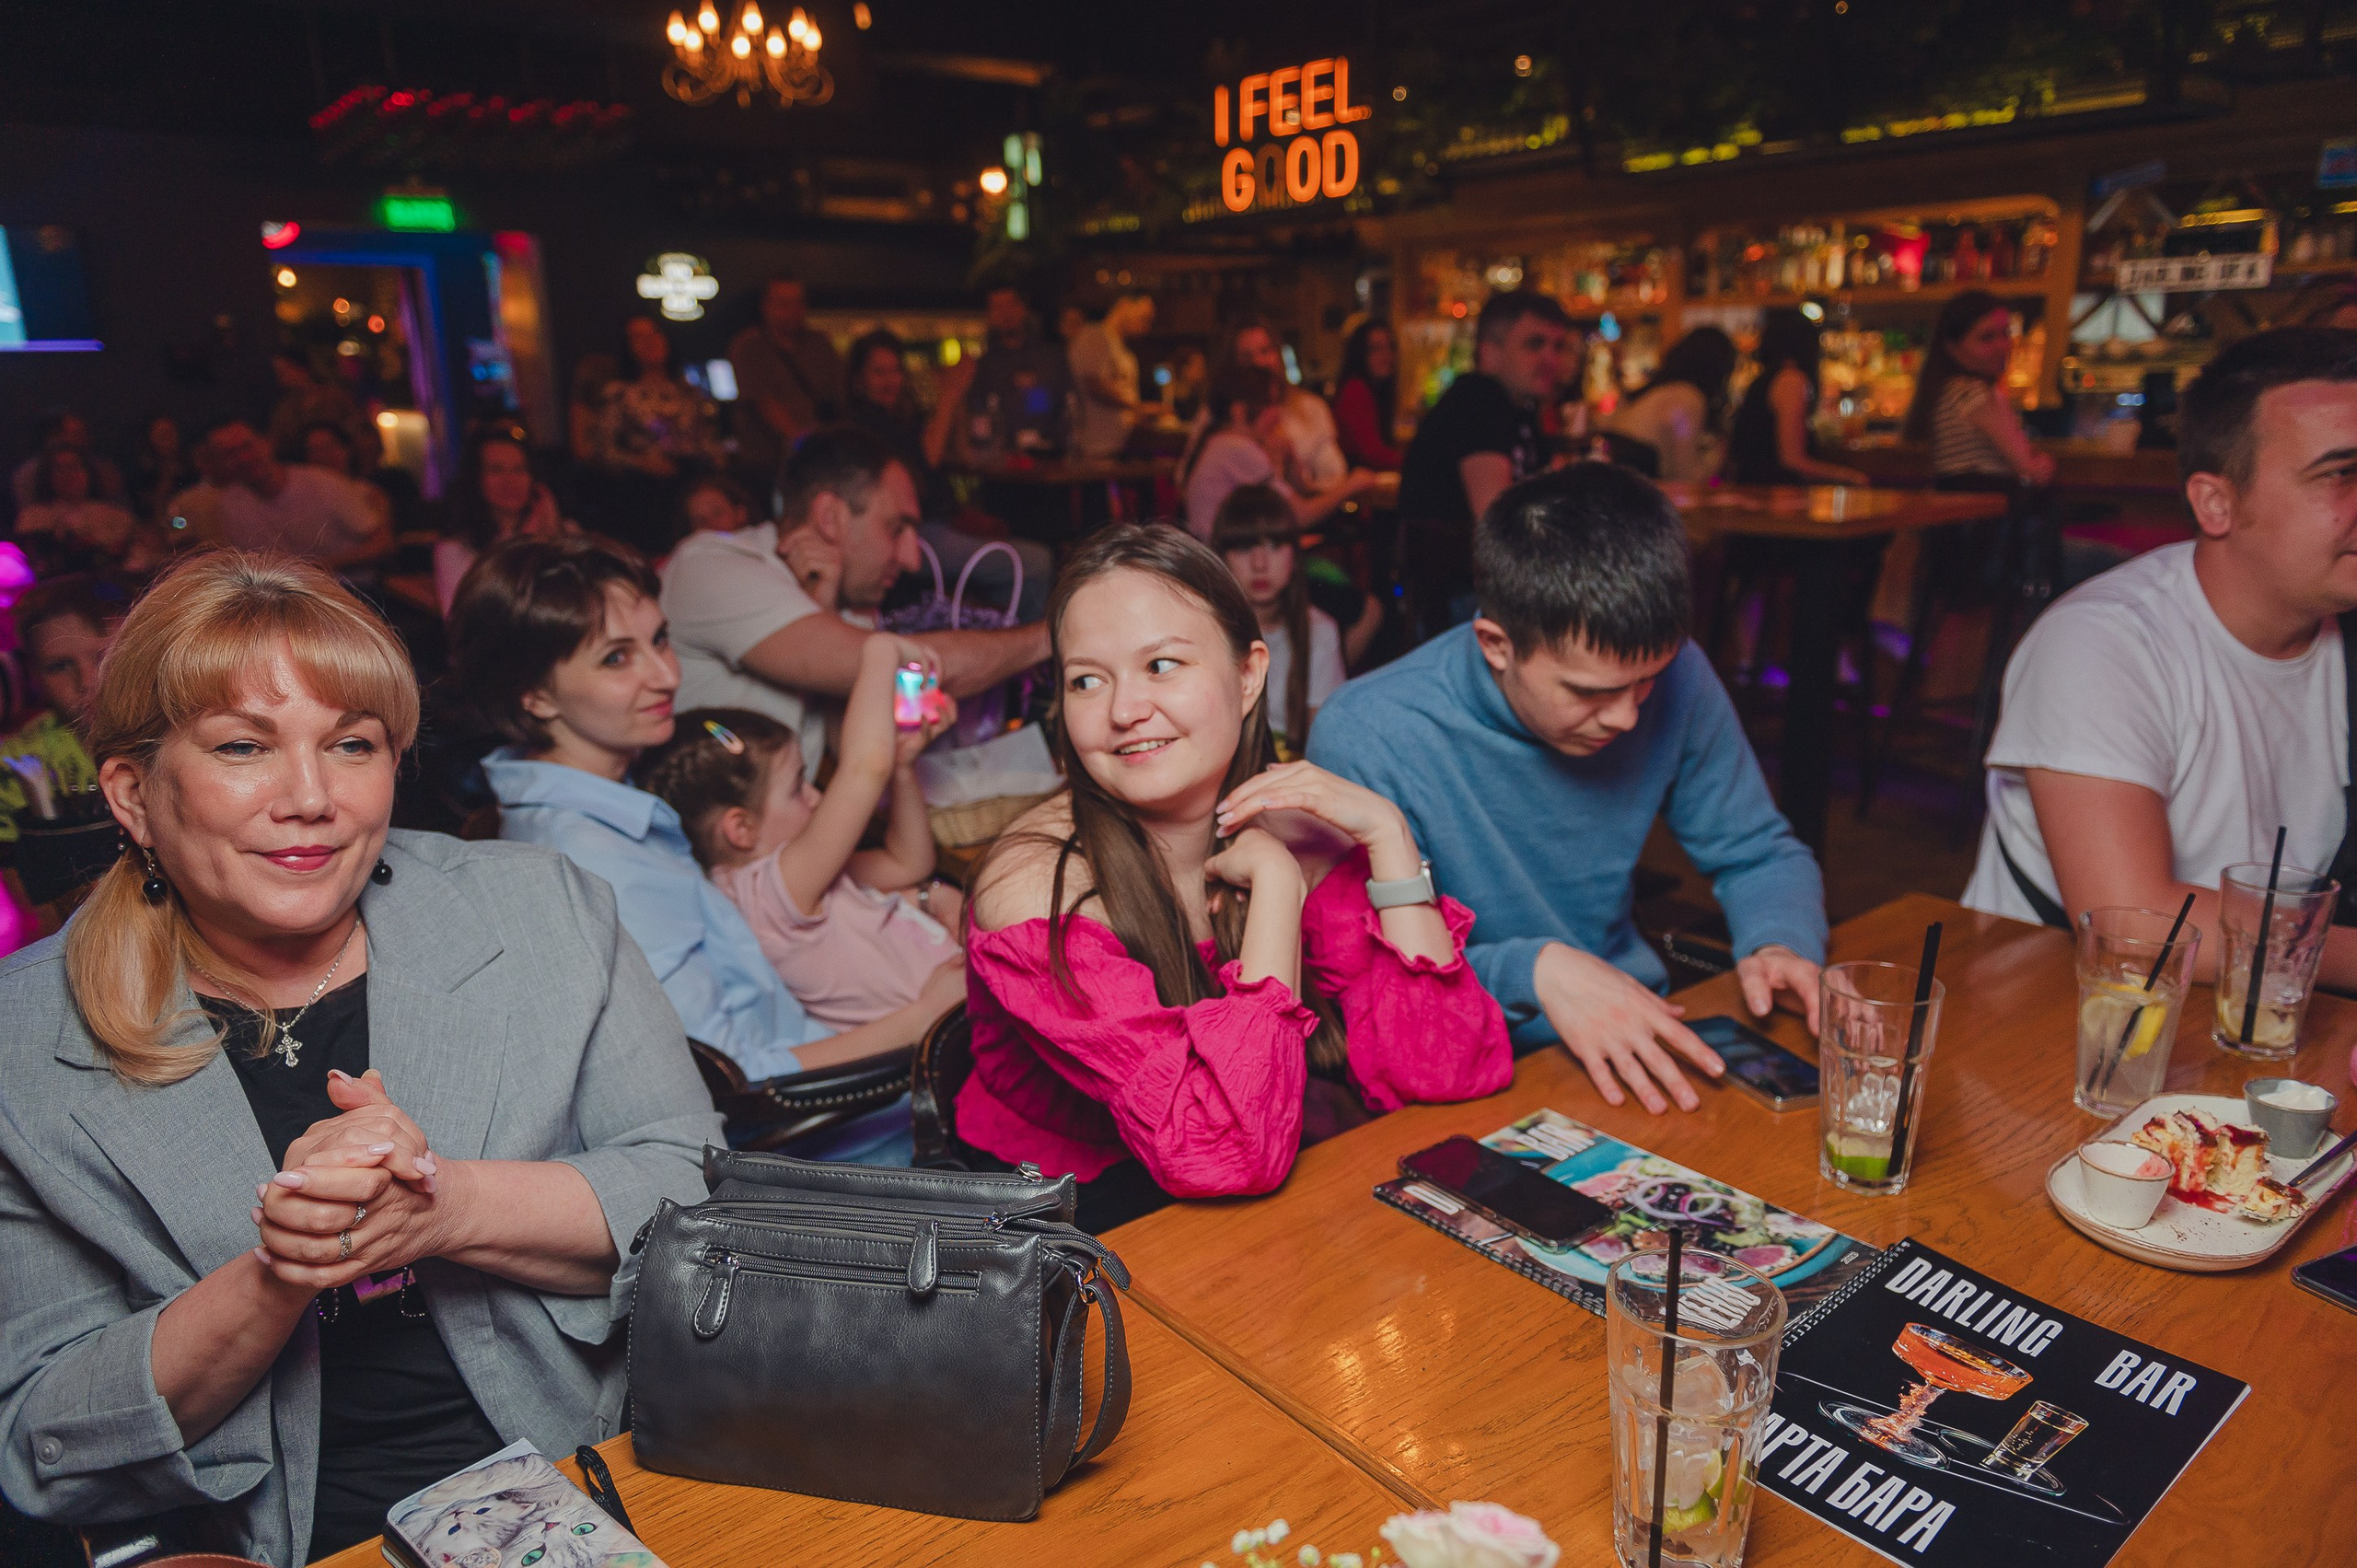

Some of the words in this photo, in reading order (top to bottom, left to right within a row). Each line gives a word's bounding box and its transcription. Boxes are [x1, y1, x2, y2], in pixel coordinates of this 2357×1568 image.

[1214, 84, 1229, 147] I
[1239, 56, 1372, 142] FEEL
[1222, 130, 1359, 213] GOOD
[1885, 1257, 2063, 1358] DARLING
[2094, 1349, 2197, 1416] BAR
[1757, 1411, 1850, 1495] АРТА
[1825, 1460, 1956, 1554] БАРА
